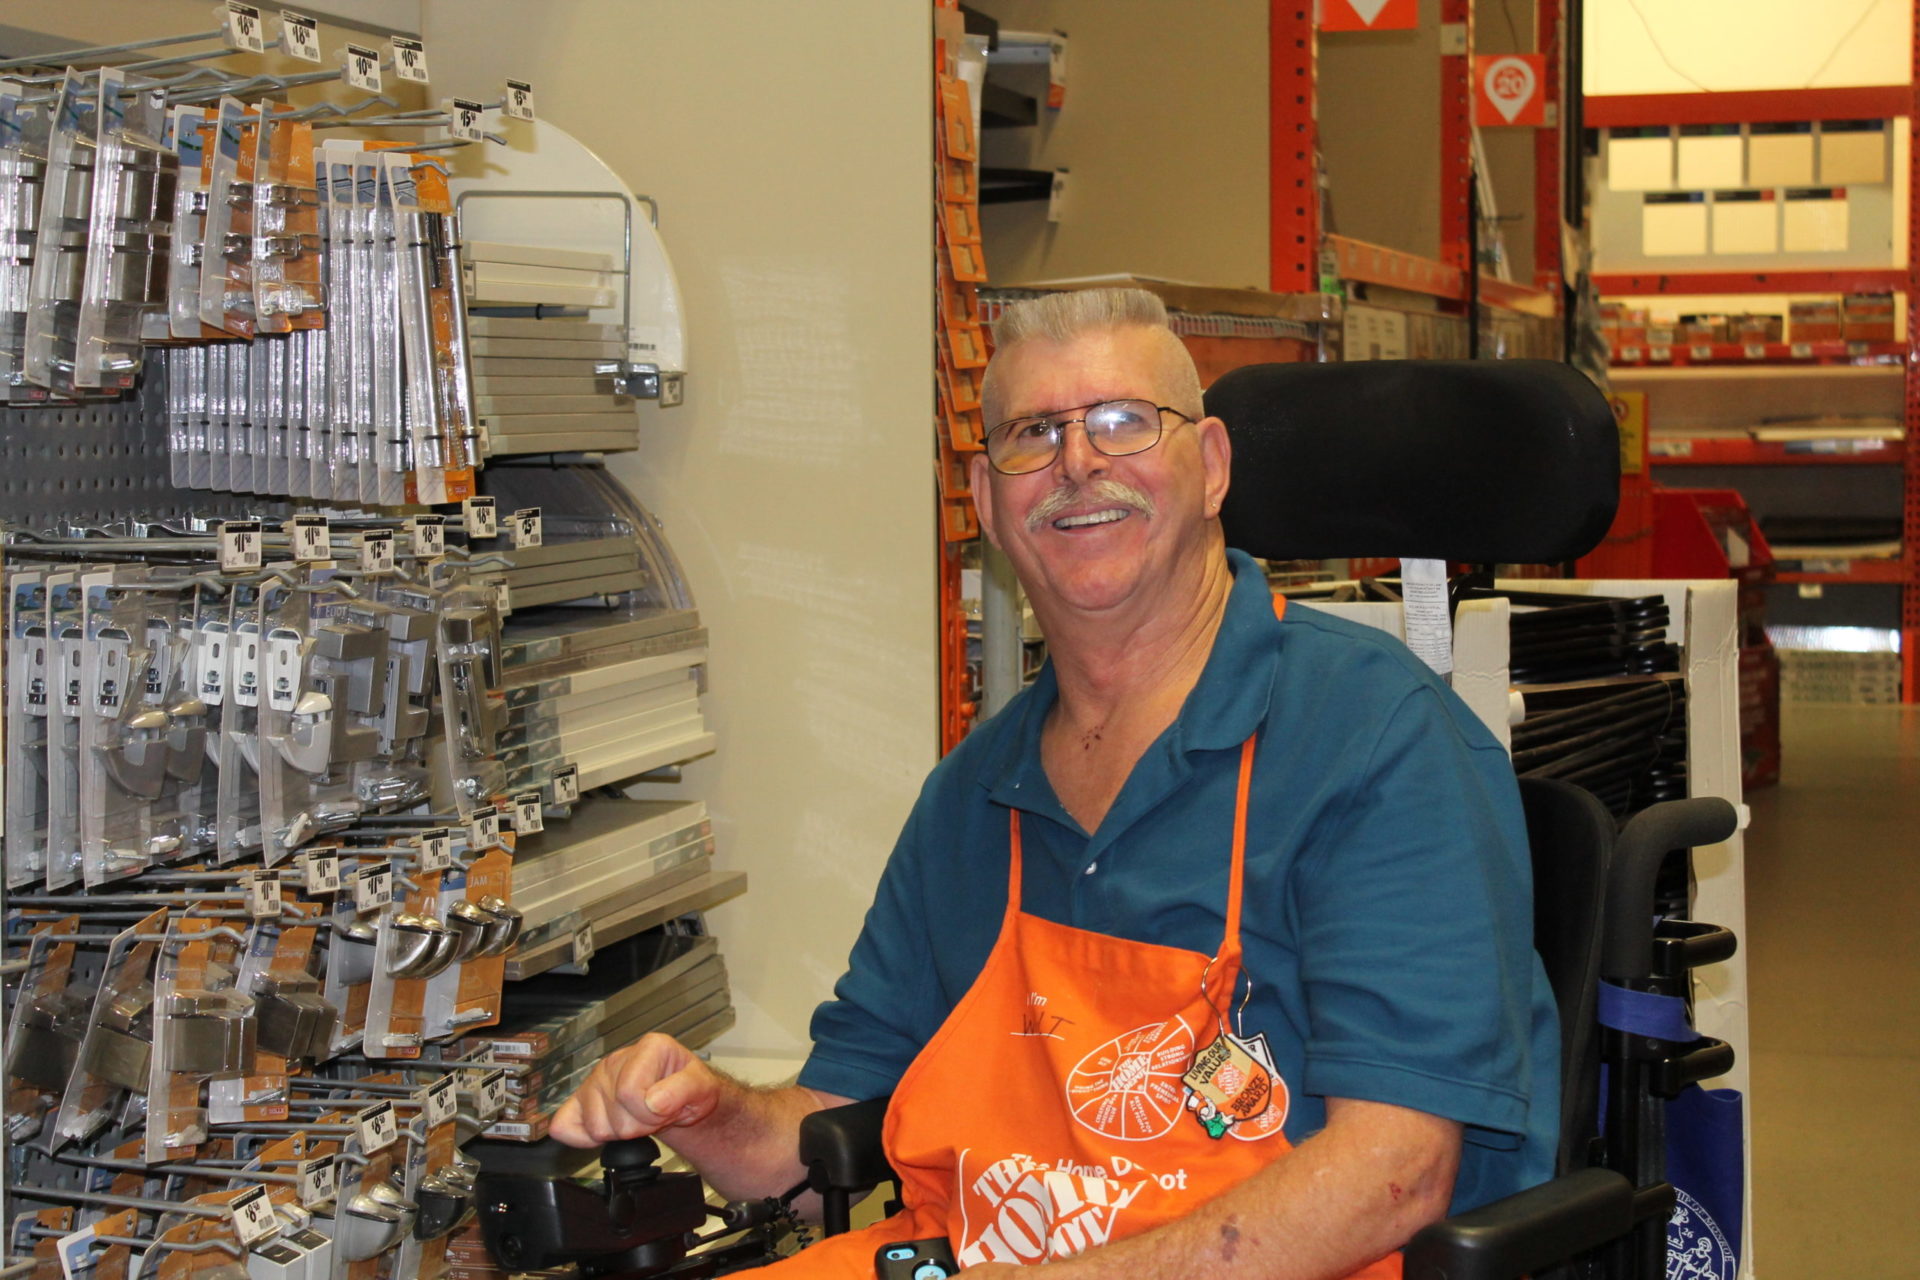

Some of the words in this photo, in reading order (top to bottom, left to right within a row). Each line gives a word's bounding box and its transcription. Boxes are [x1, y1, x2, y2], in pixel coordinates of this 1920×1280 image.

[469, 875, 488, 888] JAM
[1189, 1056, 1211, 1081] LIVING
[1200, 1050, 1227, 1085] VALUE
[1231, 1074, 1262, 1112] BRONZE
[1241, 1083, 1269, 1117] AWARD
[1056, 1158, 1108, 1180] Home
[1110, 1155, 1188, 1190] Dot
